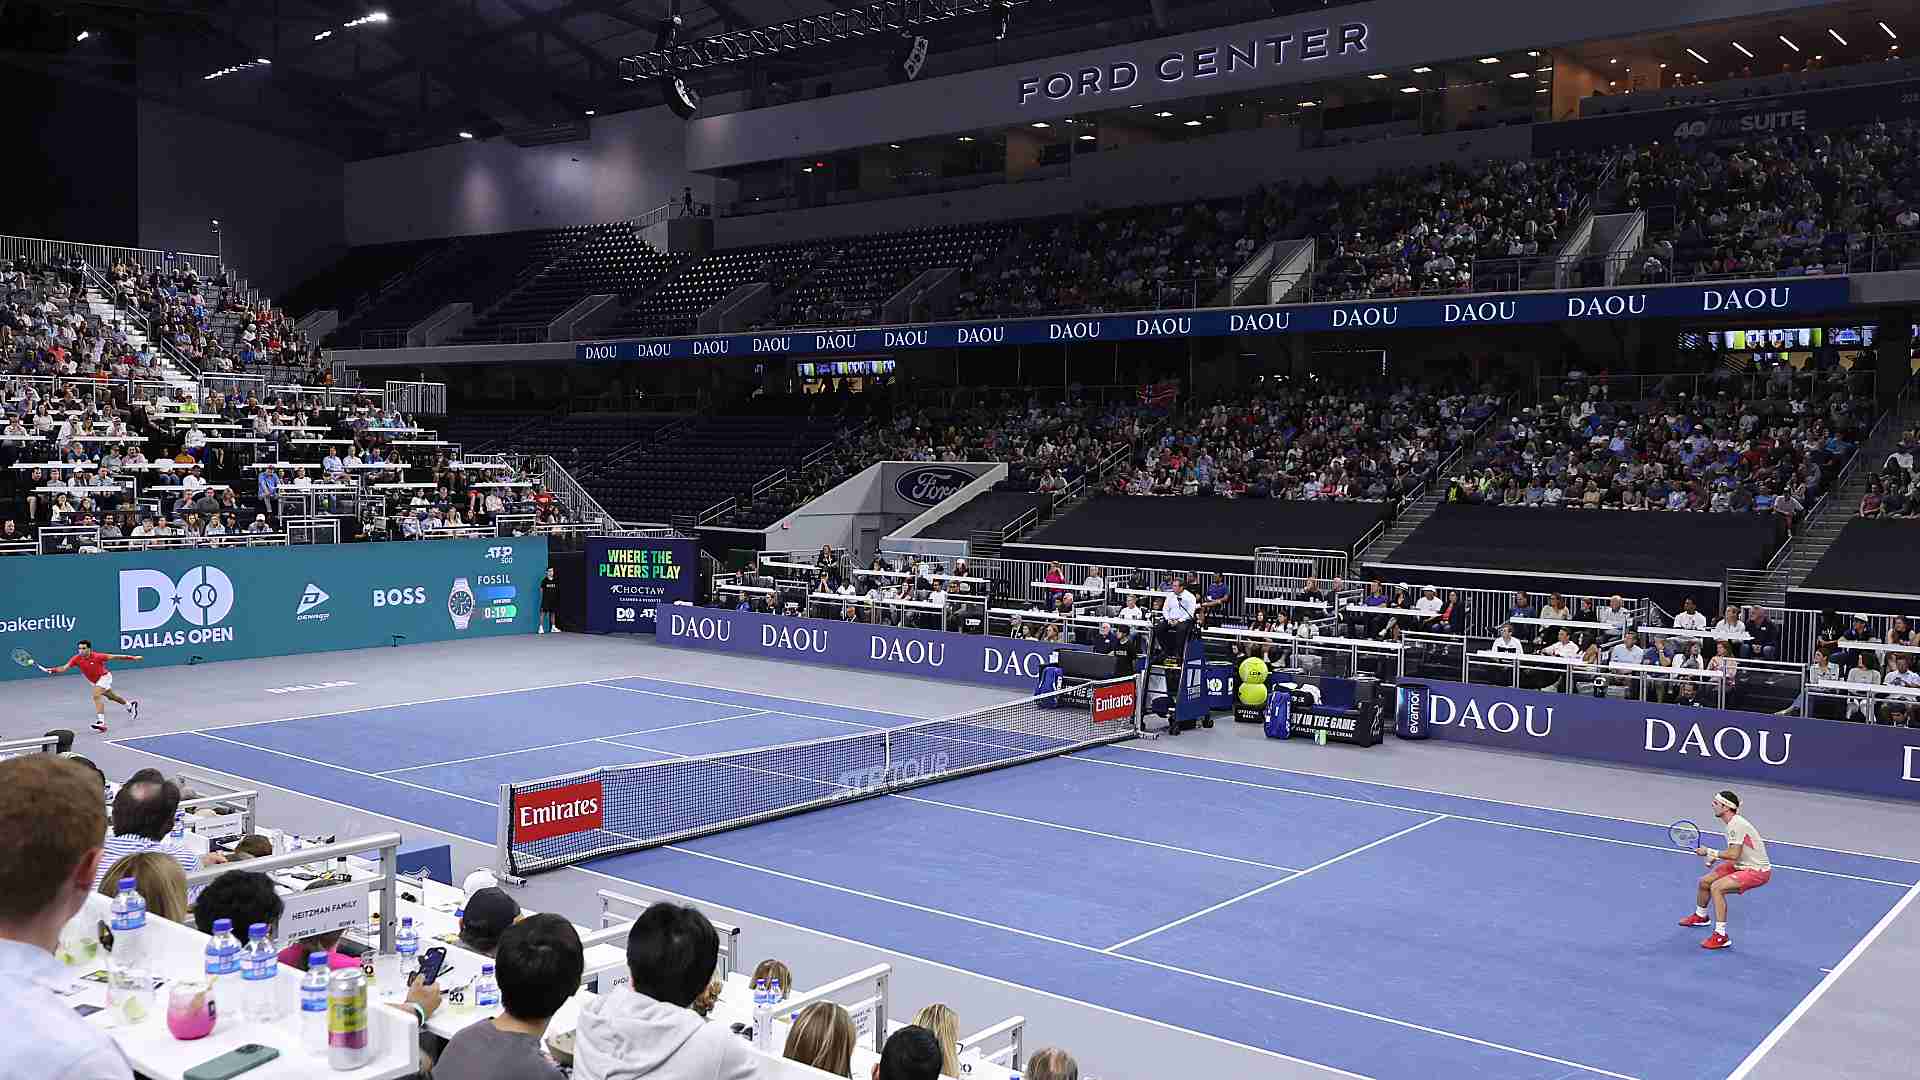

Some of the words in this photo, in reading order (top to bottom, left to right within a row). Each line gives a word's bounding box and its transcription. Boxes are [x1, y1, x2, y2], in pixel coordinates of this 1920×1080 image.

[1018, 61, 1139, 105] FORD
[1157, 22, 1370, 83] CENTER
[1740, 109, 1808, 132] SUITE
[585, 345, 617, 360] DAOU
[638, 344, 671, 357] DAOU
[693, 340, 729, 355] DAOU
[753, 337, 791, 352] DAOU
[816, 334, 857, 349] DAOU
[884, 330, 928, 347] DAOU
[957, 326, 1004, 344] DAOU
[1049, 321, 1101, 339] DAOU
[1136, 318, 1192, 336] DAOU
[1230, 313, 1290, 331] DAOU
[1332, 307, 1399, 327] DAOU
[1445, 301, 1516, 322] DAOU
[1567, 294, 1647, 317] DAOU
[1703, 287, 1790, 311] DAOU
[912, 472, 964, 500] For
[607, 549, 648, 564] WHERE
[651, 550, 673, 564] THE
[477, 574, 511, 584] FOSSIL
[599, 563, 649, 579] PLAYERS
[652, 565, 680, 580] PLAY
[373, 586, 426, 608] BOSS
[611, 584, 665, 595] CHOCTAW
[120, 631, 185, 651] DALLAS
[188, 626, 233, 644] OPEN
[671, 614, 731, 642] DAOU
[762, 624, 829, 654] DAOU
[871, 635, 945, 667] DAOU
[984, 647, 1045, 678] DAO
[1095, 693, 1134, 712] Emirates
[1409, 688, 1420, 734] evamor
[1302, 714, 1313, 726] IN
[1313, 715, 1330, 728] THE
[1330, 717, 1357, 731] GAME
[1429, 694, 1554, 737] DAOU
[1644, 718, 1792, 766] DAOU
[520, 796, 598, 828] Emirates
[291, 905, 331, 921] HEITZMAN
[331, 900, 358, 912] FAMILY
